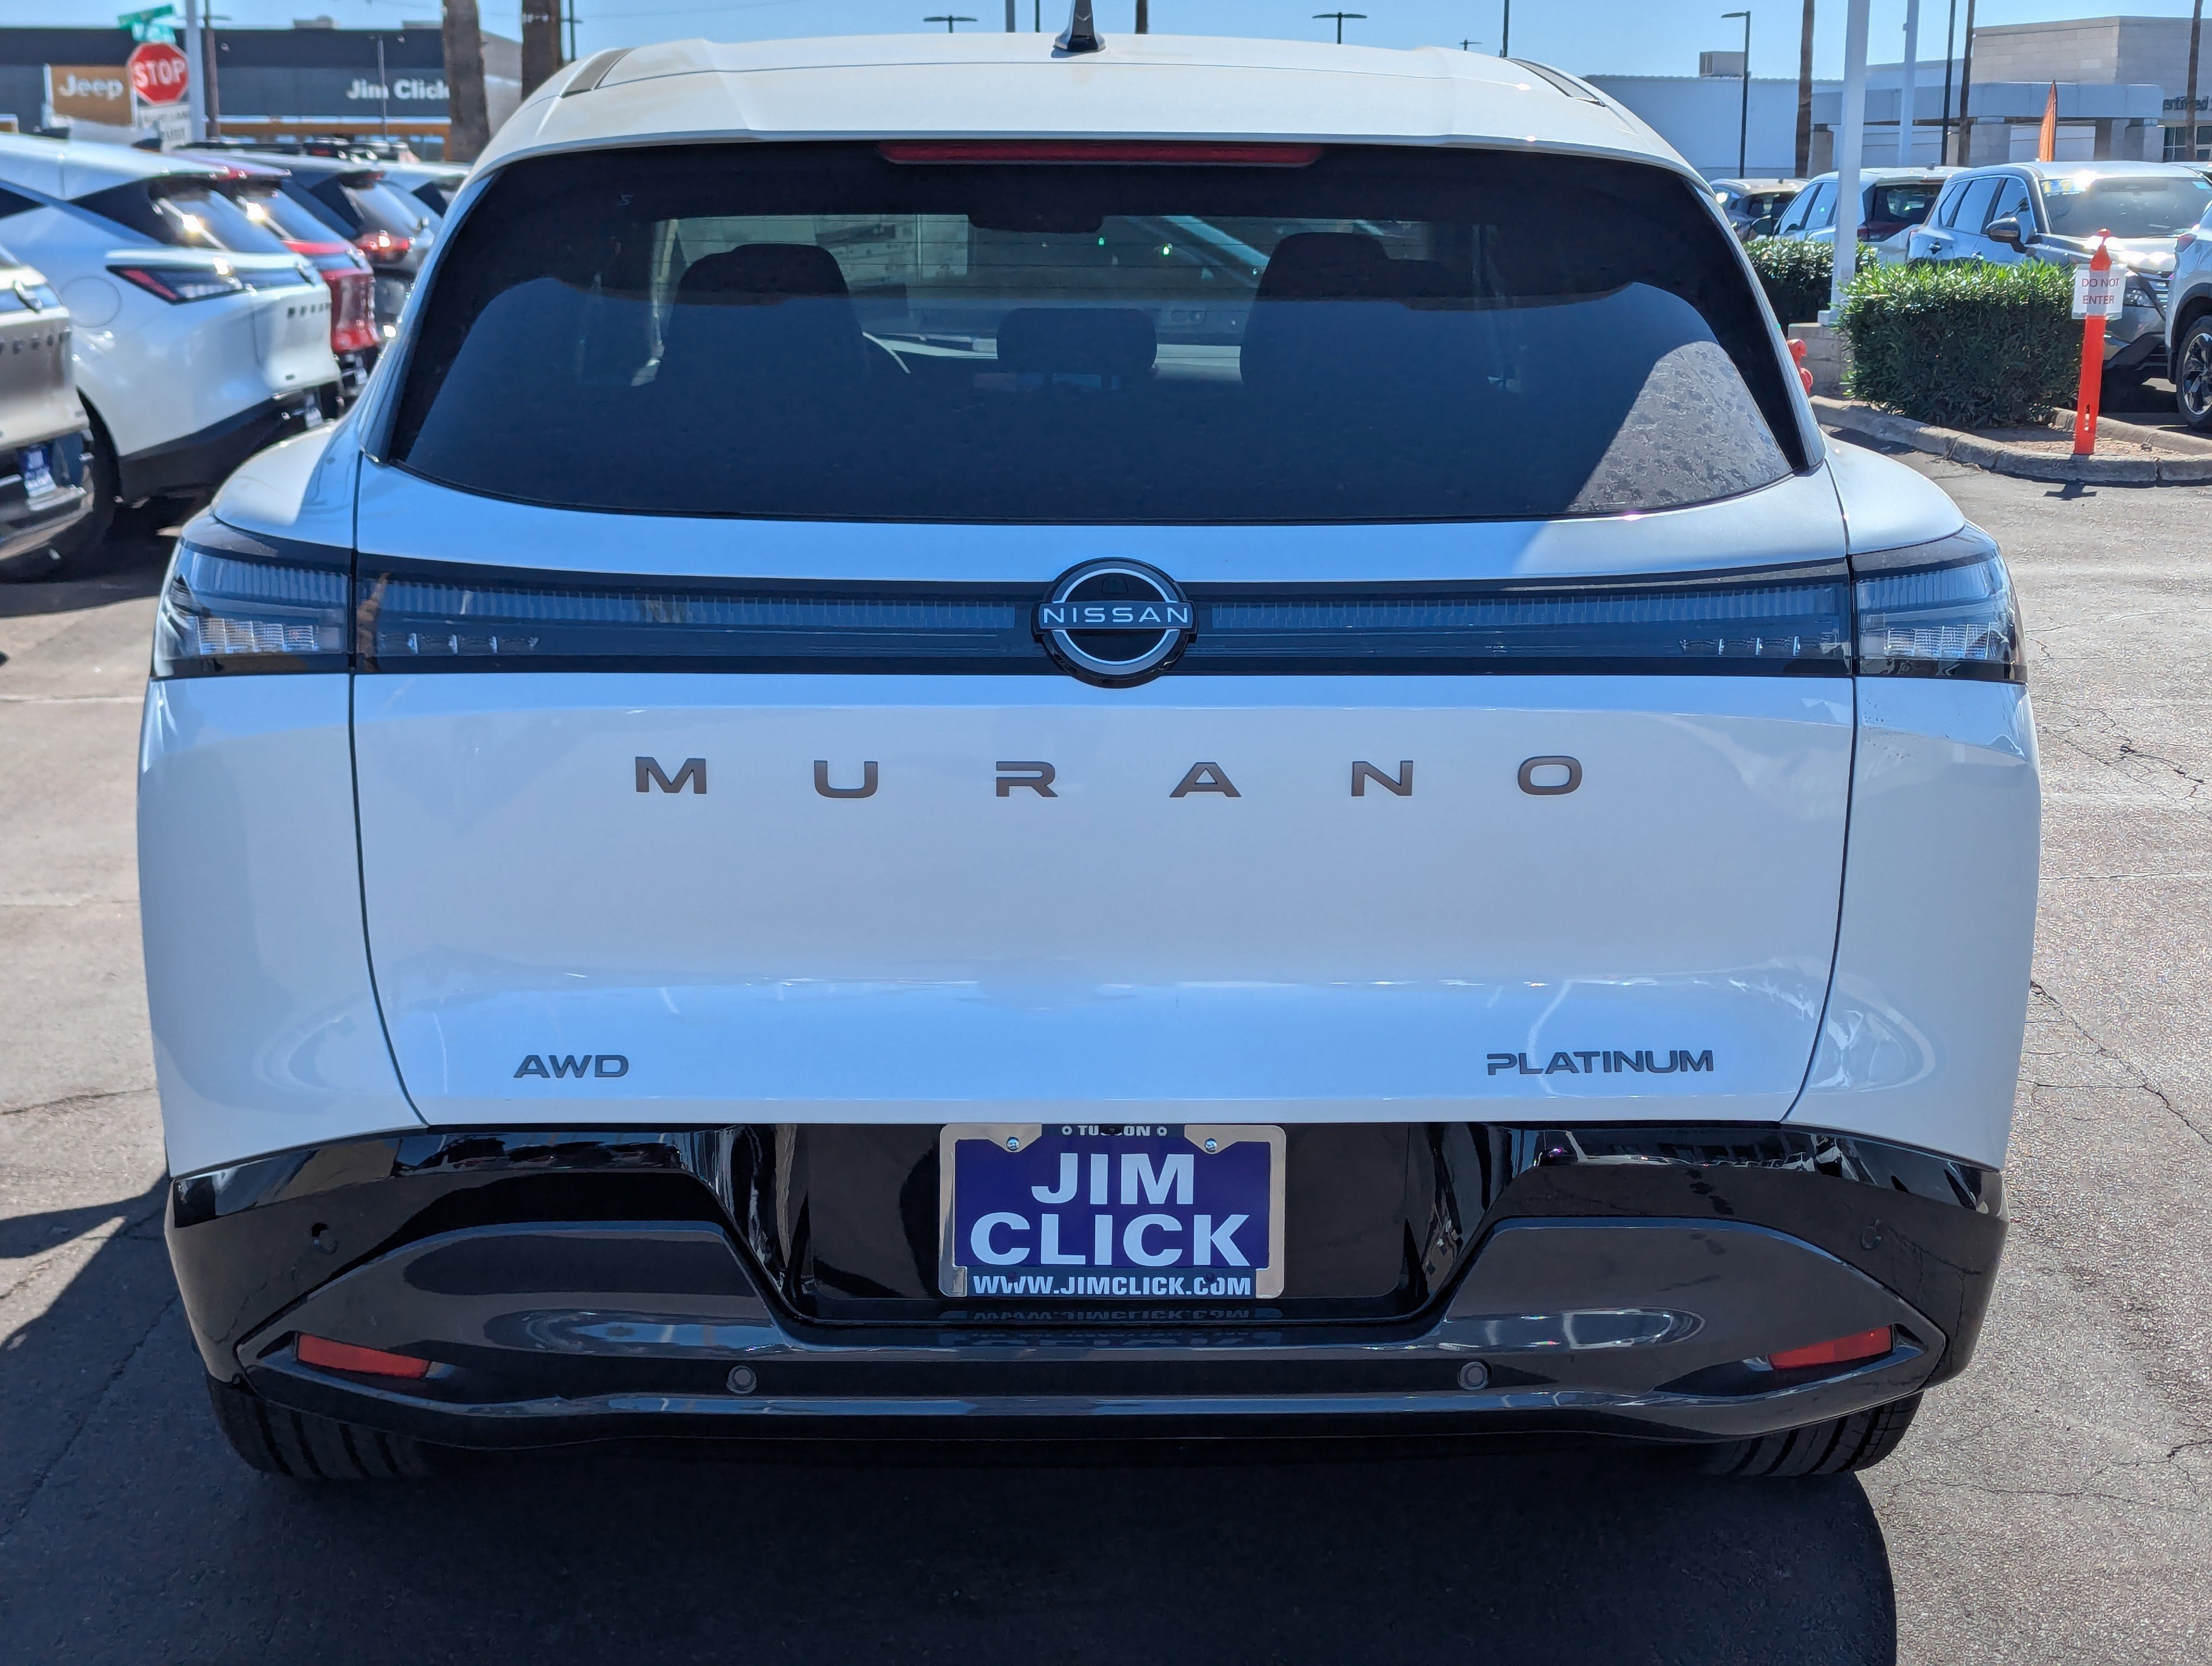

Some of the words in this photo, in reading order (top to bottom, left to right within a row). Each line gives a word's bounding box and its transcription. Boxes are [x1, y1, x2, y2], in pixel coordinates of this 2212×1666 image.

[134, 57, 186, 88] STOP
[58, 73, 124, 100] Jeep
[345, 79, 389, 99] Jim
[393, 79, 451, 99] Click
[2082, 278, 2098, 287] DO
[2101, 278, 2120, 287] NOT
[2082, 295, 2114, 304] ENTER
[1043, 606, 1188, 624] NISSAN
[635, 755, 1583, 798] MURANO
[513, 1054, 629, 1078] AWD
[1486, 1049, 1714, 1075] PLATINUM
[1077, 1125, 1151, 1136] TUON
[1031, 1152, 1194, 1205] JIM
[970, 1212, 1251, 1267] CLICK
[973, 1275, 1251, 1295] WWW.JIMCLICK.COM
